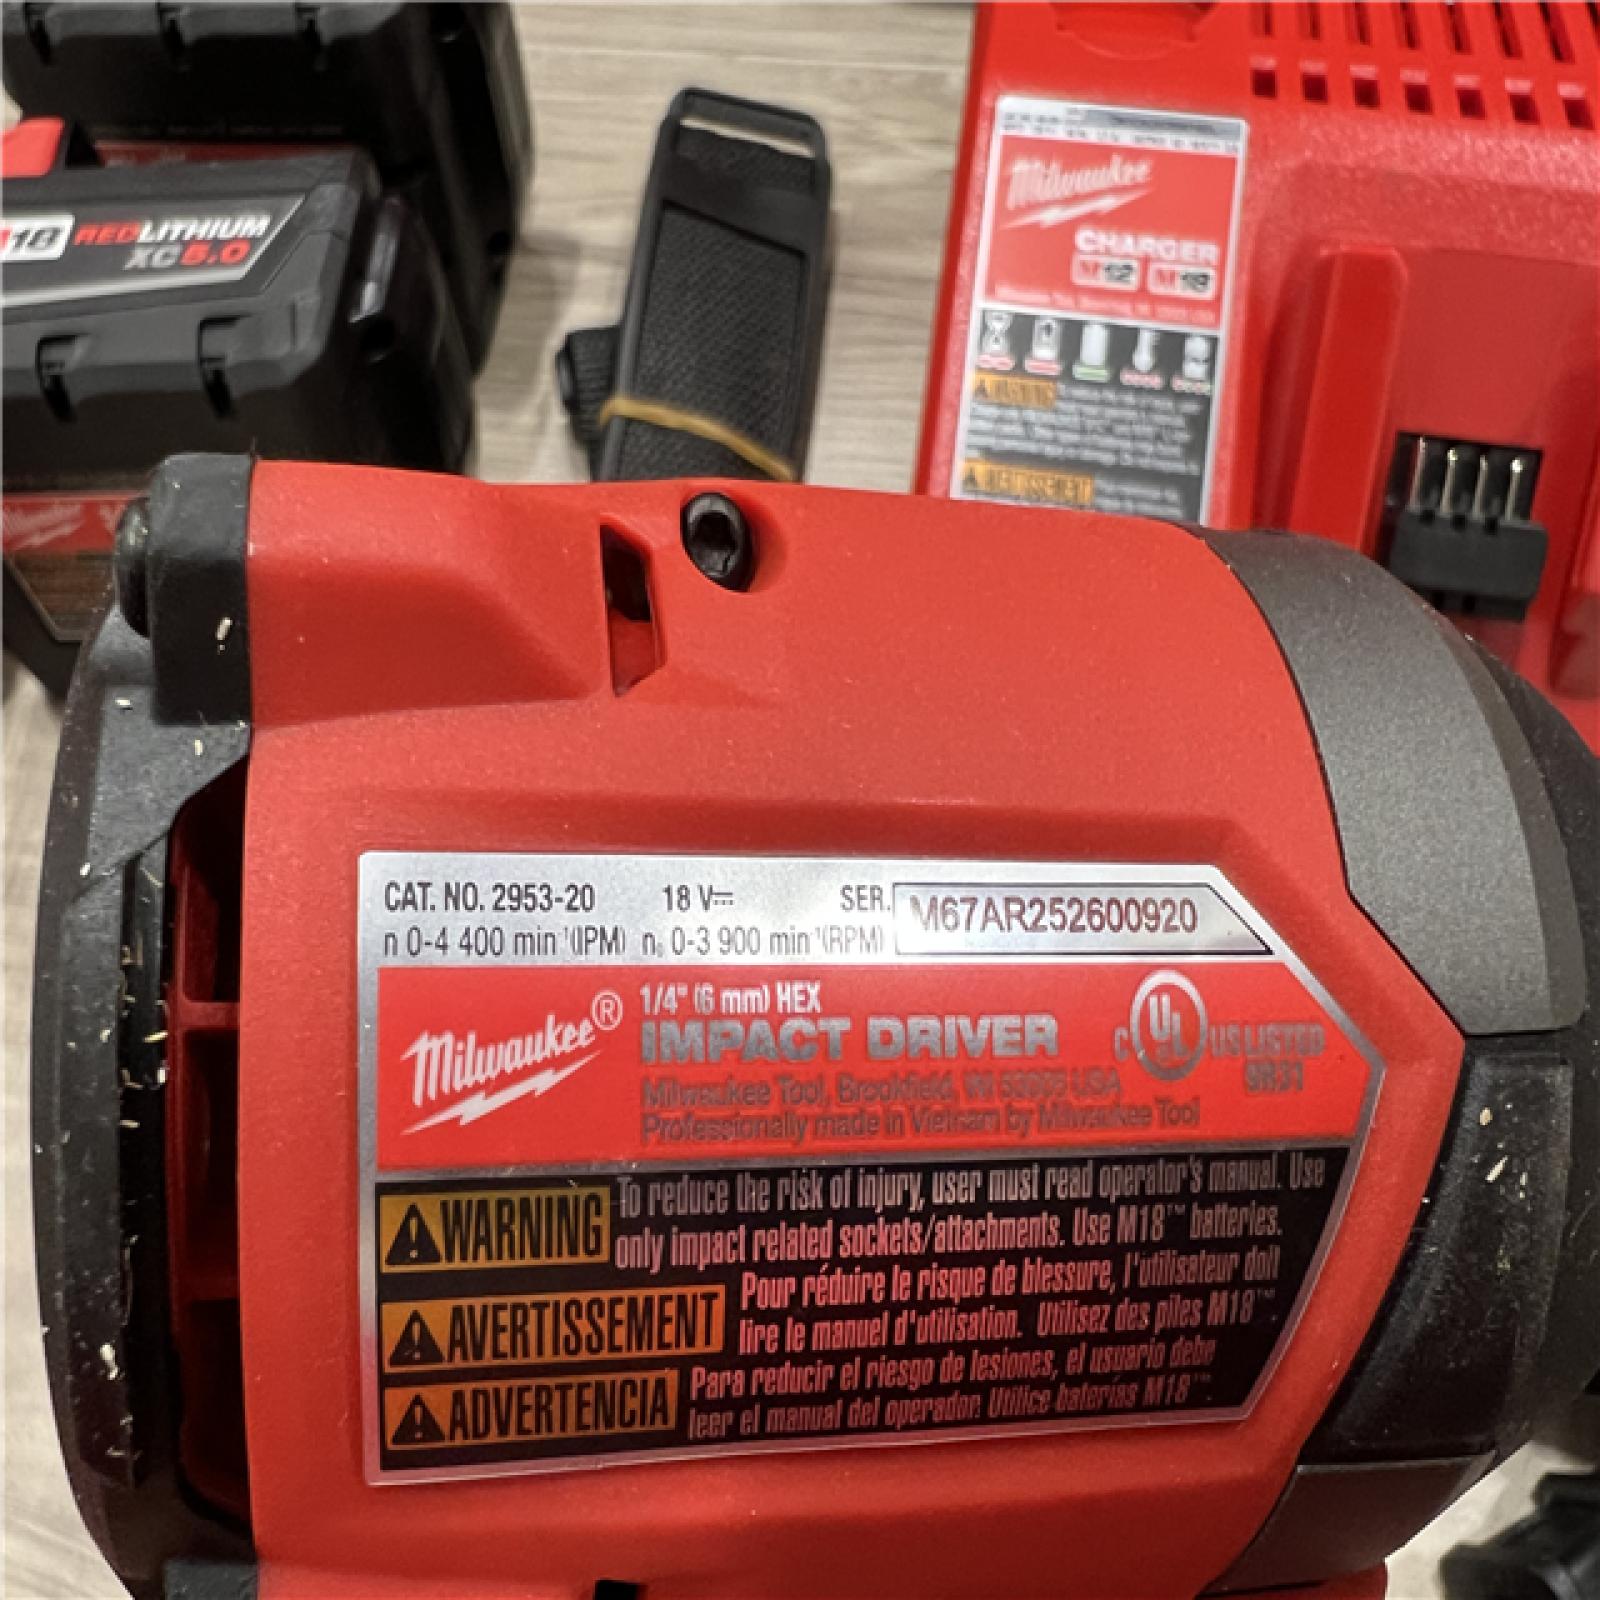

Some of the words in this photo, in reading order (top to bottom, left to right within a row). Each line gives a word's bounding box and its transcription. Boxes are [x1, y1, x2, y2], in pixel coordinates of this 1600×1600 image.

[1007, 153, 1153, 211] Milwaukee
[1074, 228, 1219, 264] CHARGER
[384, 881, 436, 912] CAT.
[444, 881, 485, 912] NO.
[492, 883, 596, 913] 2953-20
[662, 884, 691, 912] 18
[840, 884, 891, 912] SER.
[909, 895, 1198, 934] M67AR252600920
[384, 930, 399, 956] n
[406, 925, 448, 957] 0-4
[458, 925, 506, 957] 400
[671, 926, 711, 956] 0-3
[718, 926, 761, 956] 900
[719, 984, 770, 1014] mm)
[775, 979, 822, 1014] HEX
[640, 1016, 852, 1063] IMPACT
[866, 1013, 1059, 1058] DRIVER
[1244, 1022, 1325, 1058] LISTED
[642, 1076, 771, 1107] Milwaukee
[1072, 1066, 1122, 1098] USA
[642, 1109, 808, 1142] Professionally
[813, 1109, 879, 1137] made
[885, 1108, 905, 1135] in
[909, 1102, 999, 1133] Vietnam
[1006, 1101, 1032, 1138] by
[1038, 1098, 1152, 1131] Milwaukee
[1155, 1096, 1200, 1127] Tool
[616, 1176, 642, 1219] To
[648, 1173, 729, 1217] reduce
[736, 1171, 770, 1214] the
[777, 1168, 823, 1212] risk
[829, 1167, 851, 1210] of
[857, 1166, 926, 1214] injury,
[932, 1169, 983, 1205] user
[988, 1162, 1040, 1204] must
[1045, 1158, 1093, 1199] read
[1099, 1154, 1203, 1204] operator's
[1208, 1152, 1282, 1194] manual.
[1289, 1151, 1326, 1190] Use
[440, 1191, 604, 1265] WARNING
[614, 1226, 665, 1275] only
[671, 1223, 747, 1273] impact
[752, 1218, 834, 1263] related
[839, 1211, 1066, 1258] sockets/attachments.
[1072, 1206, 1112, 1246] Use
[1189, 1199, 1284, 1241] batteries.
[740, 1270, 797, 1311] Pour
[802, 1262, 887, 1308] réduire
[891, 1263, 913, 1302] le
[917, 1262, 987, 1306] risque
[991, 1258, 1018, 1297] de
[1022, 1255, 1116, 1297] blessure,
[1244, 1244, 1282, 1282] doit
[447, 1290, 720, 1364] AVERTISSEMENT
[738, 1317, 780, 1356] lire
[785, 1316, 807, 1354] le
[811, 1309, 889, 1352] manuel
[893, 1303, 1023, 1347] d'utilisation.
[1036, 1299, 1112, 1338] Utilisez
[1115, 1296, 1150, 1333] des
[1154, 1292, 1204, 1336] piles
[690, 1364, 746, 1401] Para
[751, 1358, 836, 1397] reducir
[839, 1355, 862, 1392] el
[864, 1354, 936, 1392] riesgo
[938, 1350, 966, 1384] de
[969, 1347, 1059, 1382] lesiones,
[1065, 1340, 1088, 1376] el
[1089, 1336, 1166, 1374] usuario
[1169, 1333, 1217, 1368] debe
[448, 1375, 670, 1442] ADVERTENCIA
[687, 1406, 736, 1442] leer
[739, 1401, 762, 1437] el
[765, 1397, 844, 1434] manual
[846, 1394, 882, 1428] del
[986, 1383, 1052, 1419] Utilice
